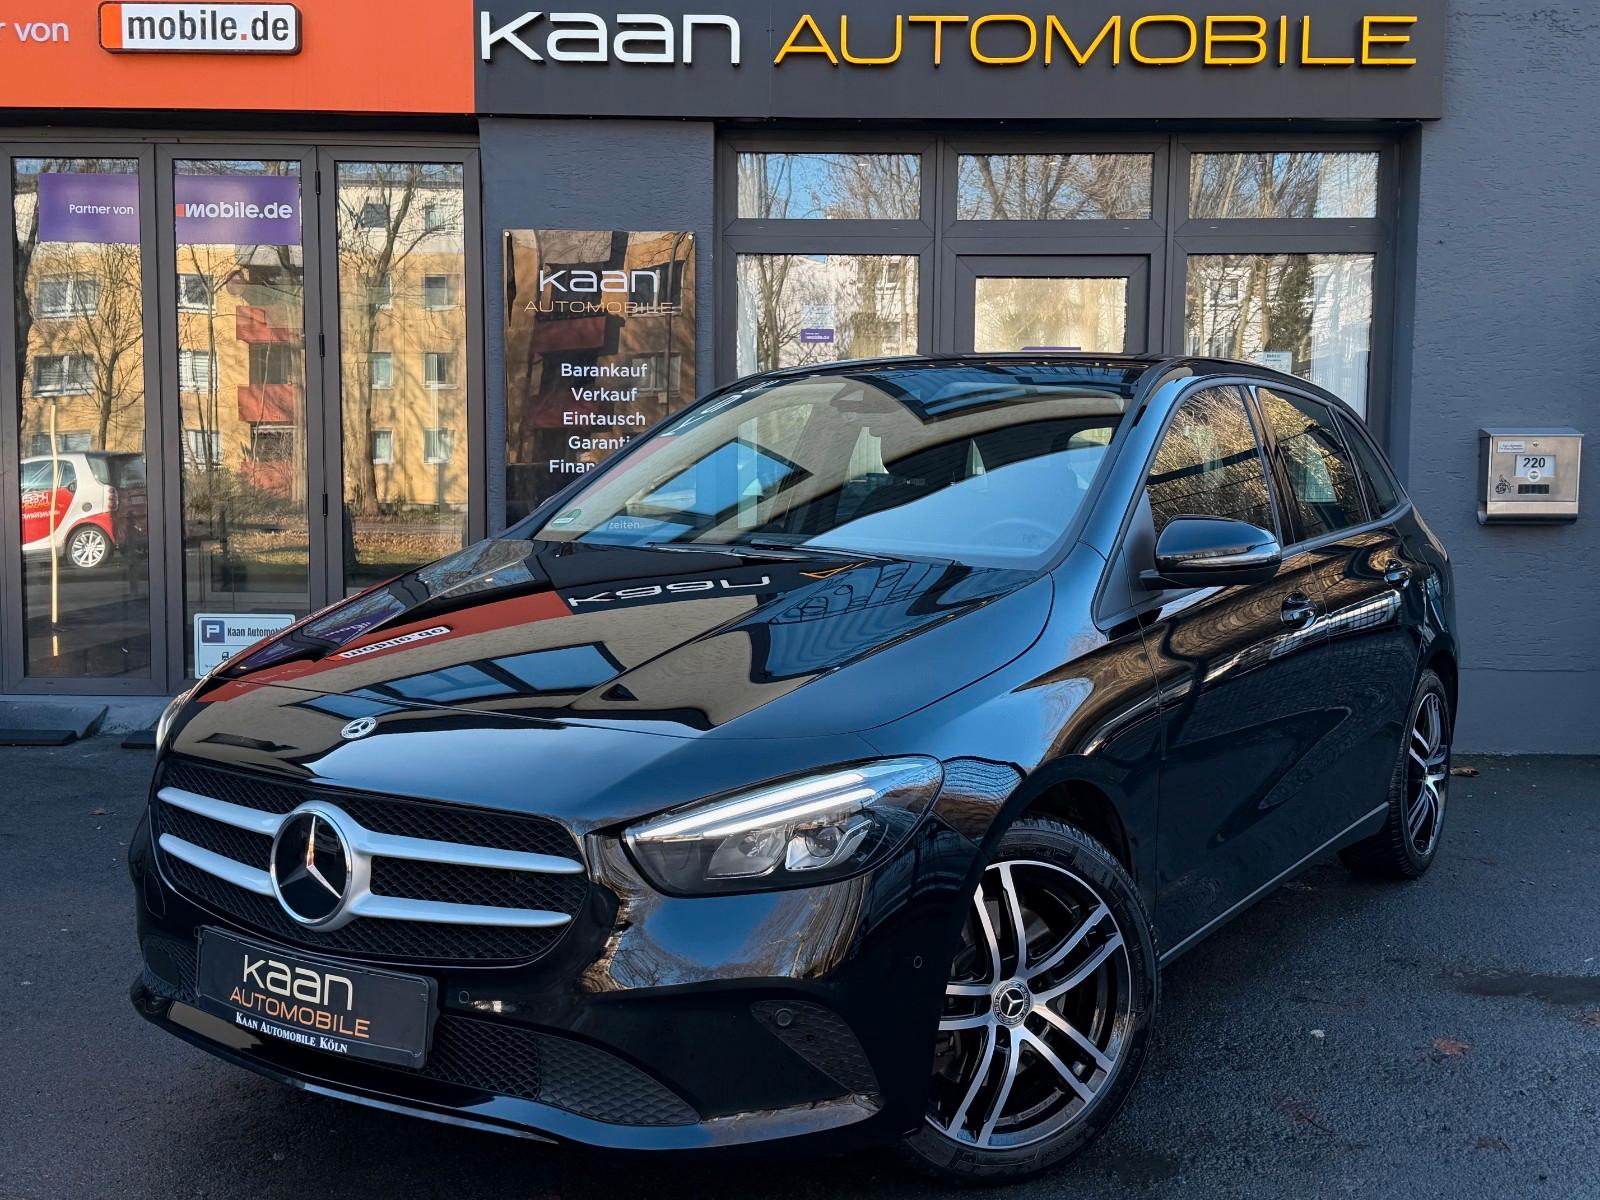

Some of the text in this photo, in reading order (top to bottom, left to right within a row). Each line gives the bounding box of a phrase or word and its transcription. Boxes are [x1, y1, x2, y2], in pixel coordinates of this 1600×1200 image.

[13, 22, 70, 42] von
[127, 10, 290, 42] mobile.de
[480, 10, 1418, 66] kaan AUTOMOBILE
[69, 201, 293, 219] Partner von mobile.de
[539, 269, 657, 293] kaan
[523, 300, 673, 314] AUTOMOBILE
[561, 363, 648, 378] Barankauf
[571, 387, 638, 402] Verkauf
[563, 411, 646, 426] Eintausch
[1522, 457, 1546, 469] 220
[227, 627, 245, 637] Kaan
[243, 954, 353, 1011] kaan
[229, 985, 371, 1039] AUTOMOBILE
